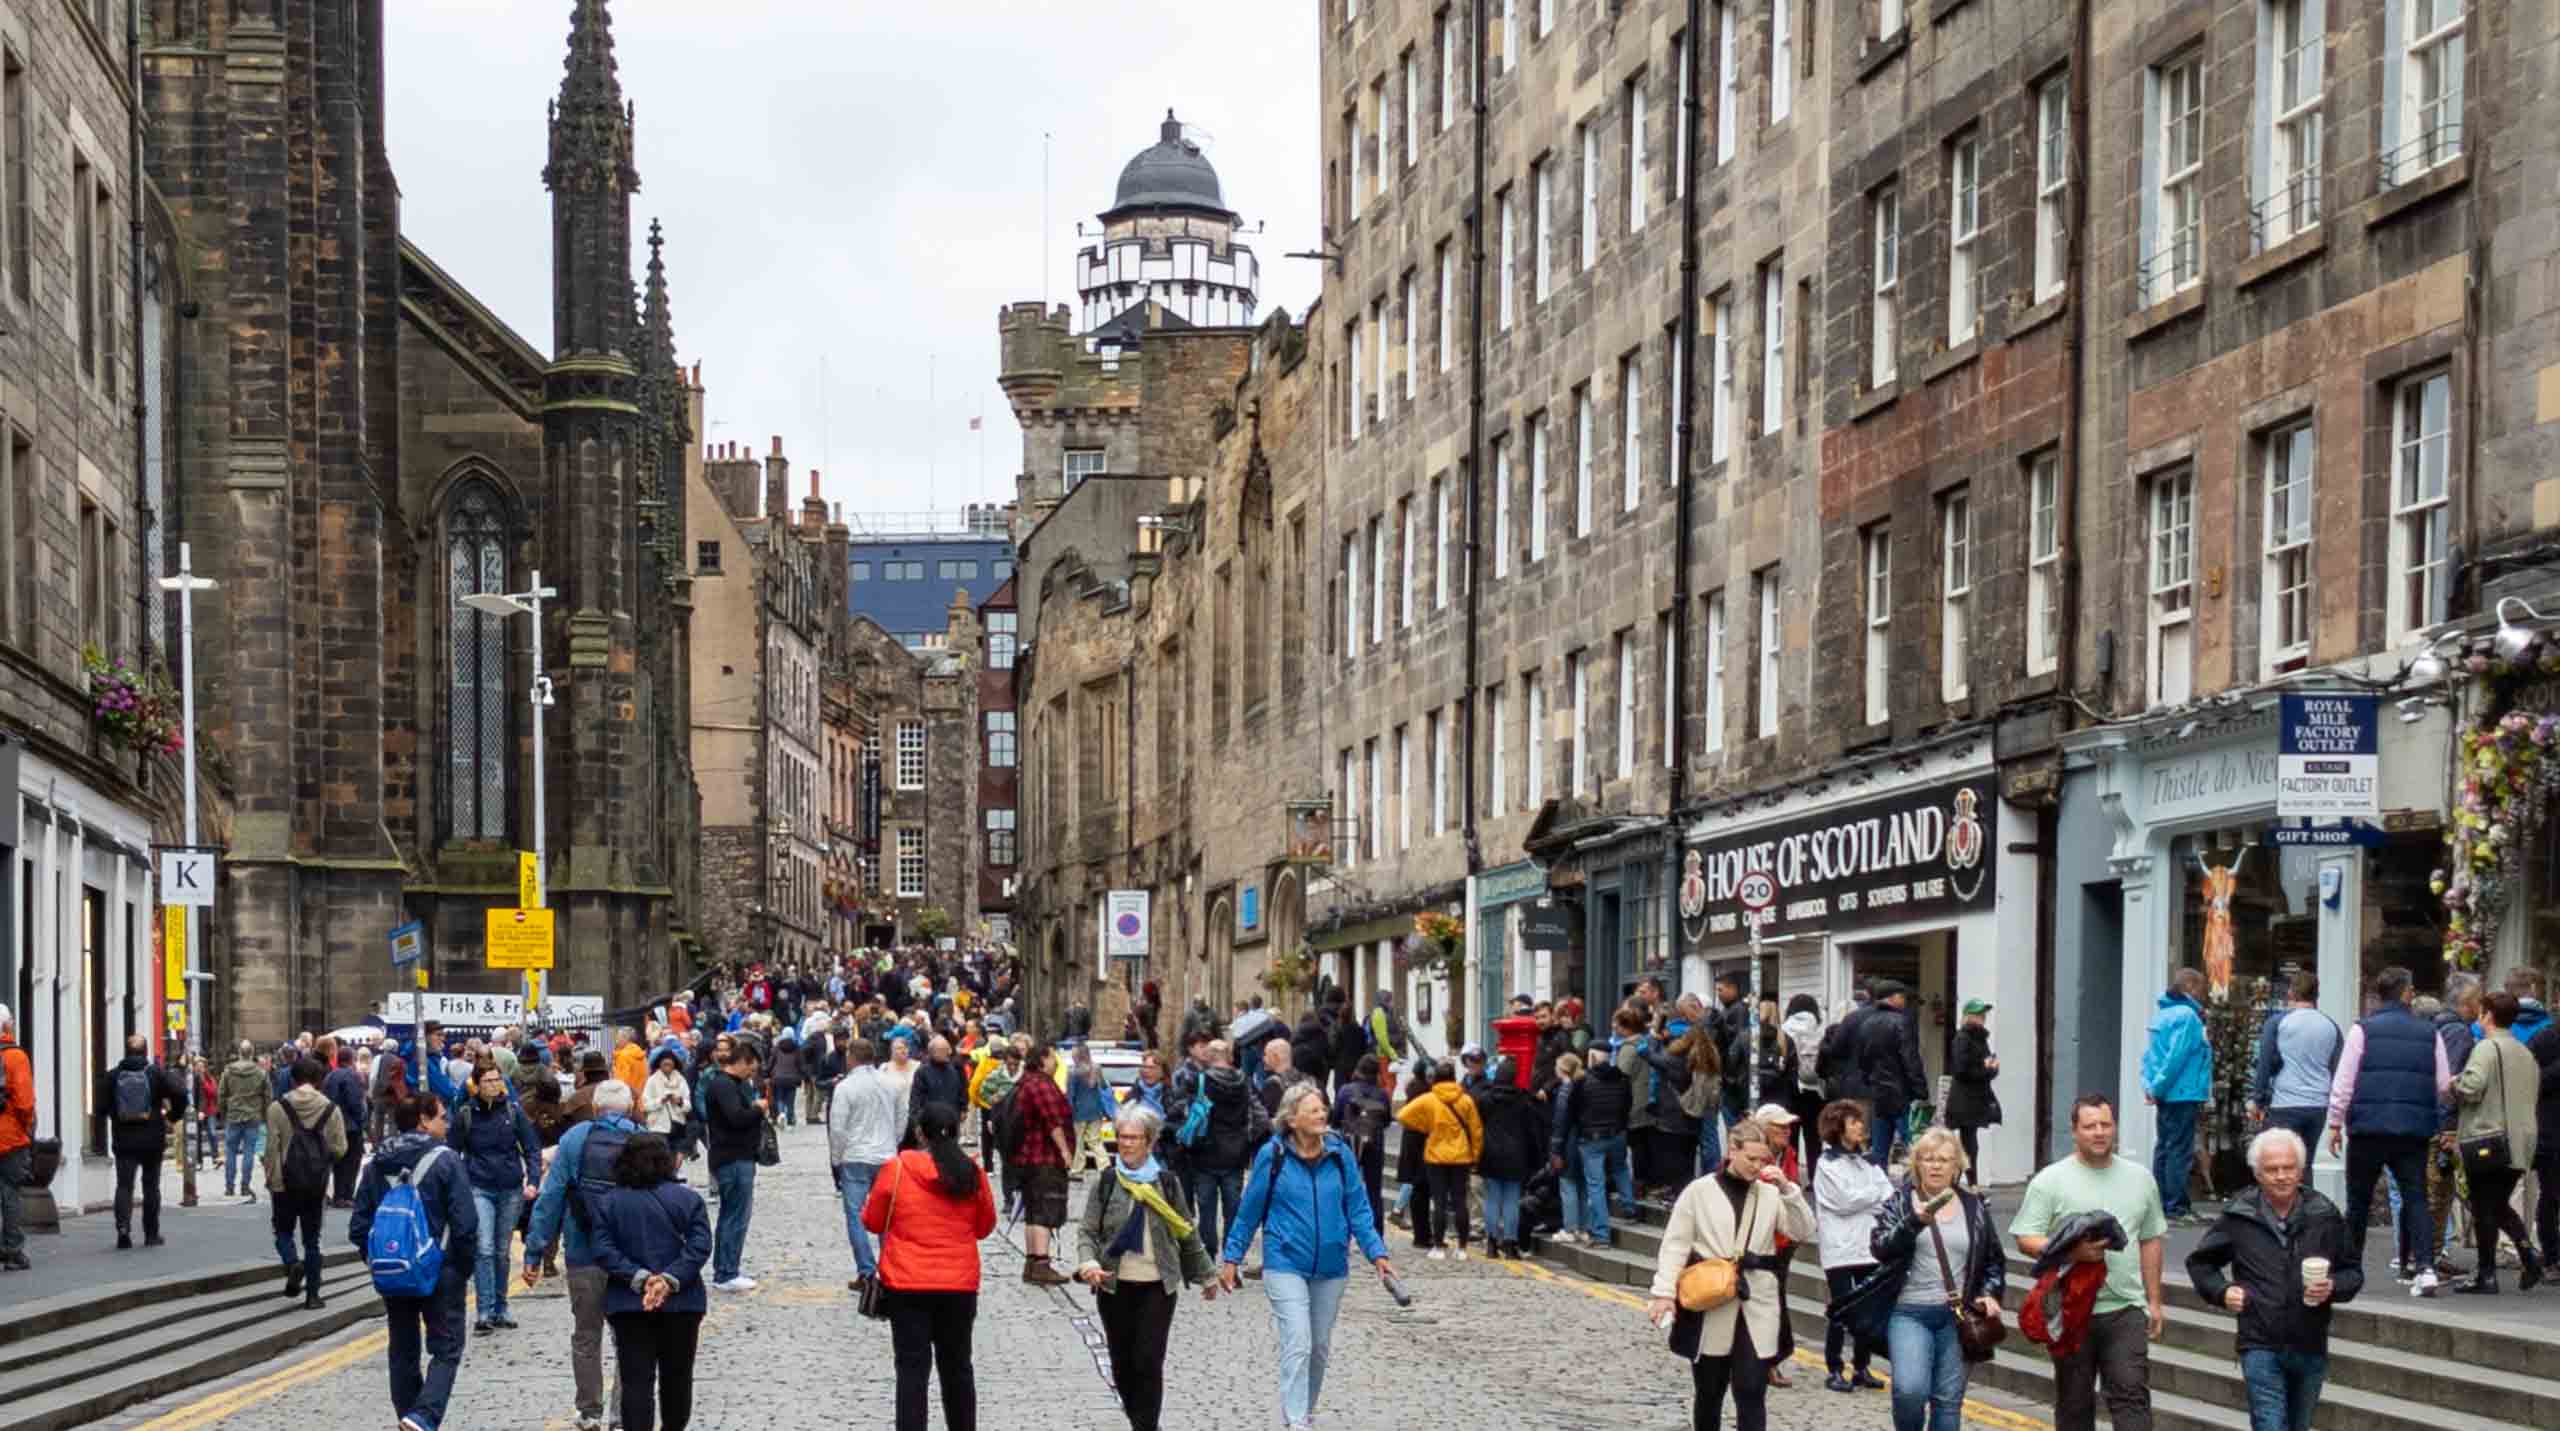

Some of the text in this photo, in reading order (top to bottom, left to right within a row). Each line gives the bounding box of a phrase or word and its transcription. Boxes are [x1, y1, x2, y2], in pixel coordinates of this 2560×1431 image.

[2304, 699, 2353, 713] ROYAL
[2309, 712, 2347, 726] MILE
[2295, 725, 2361, 739] FACTORY
[2297, 738, 2357, 752] OUTLET
[2152, 759, 2208, 805] Thistle
[2213, 752, 2237, 792] do
[2280, 776, 2374, 793] FACTORY OUTLET
[2275, 830, 2351, 842] GIFT SHOP
[1707, 805, 1944, 902] HOUSE OF SCOTLAND
[176, 860, 198, 889] K
[1744, 883, 1769, 898] 20
[440, 997, 475, 1014] Fish
[483, 998, 495, 1013] &
